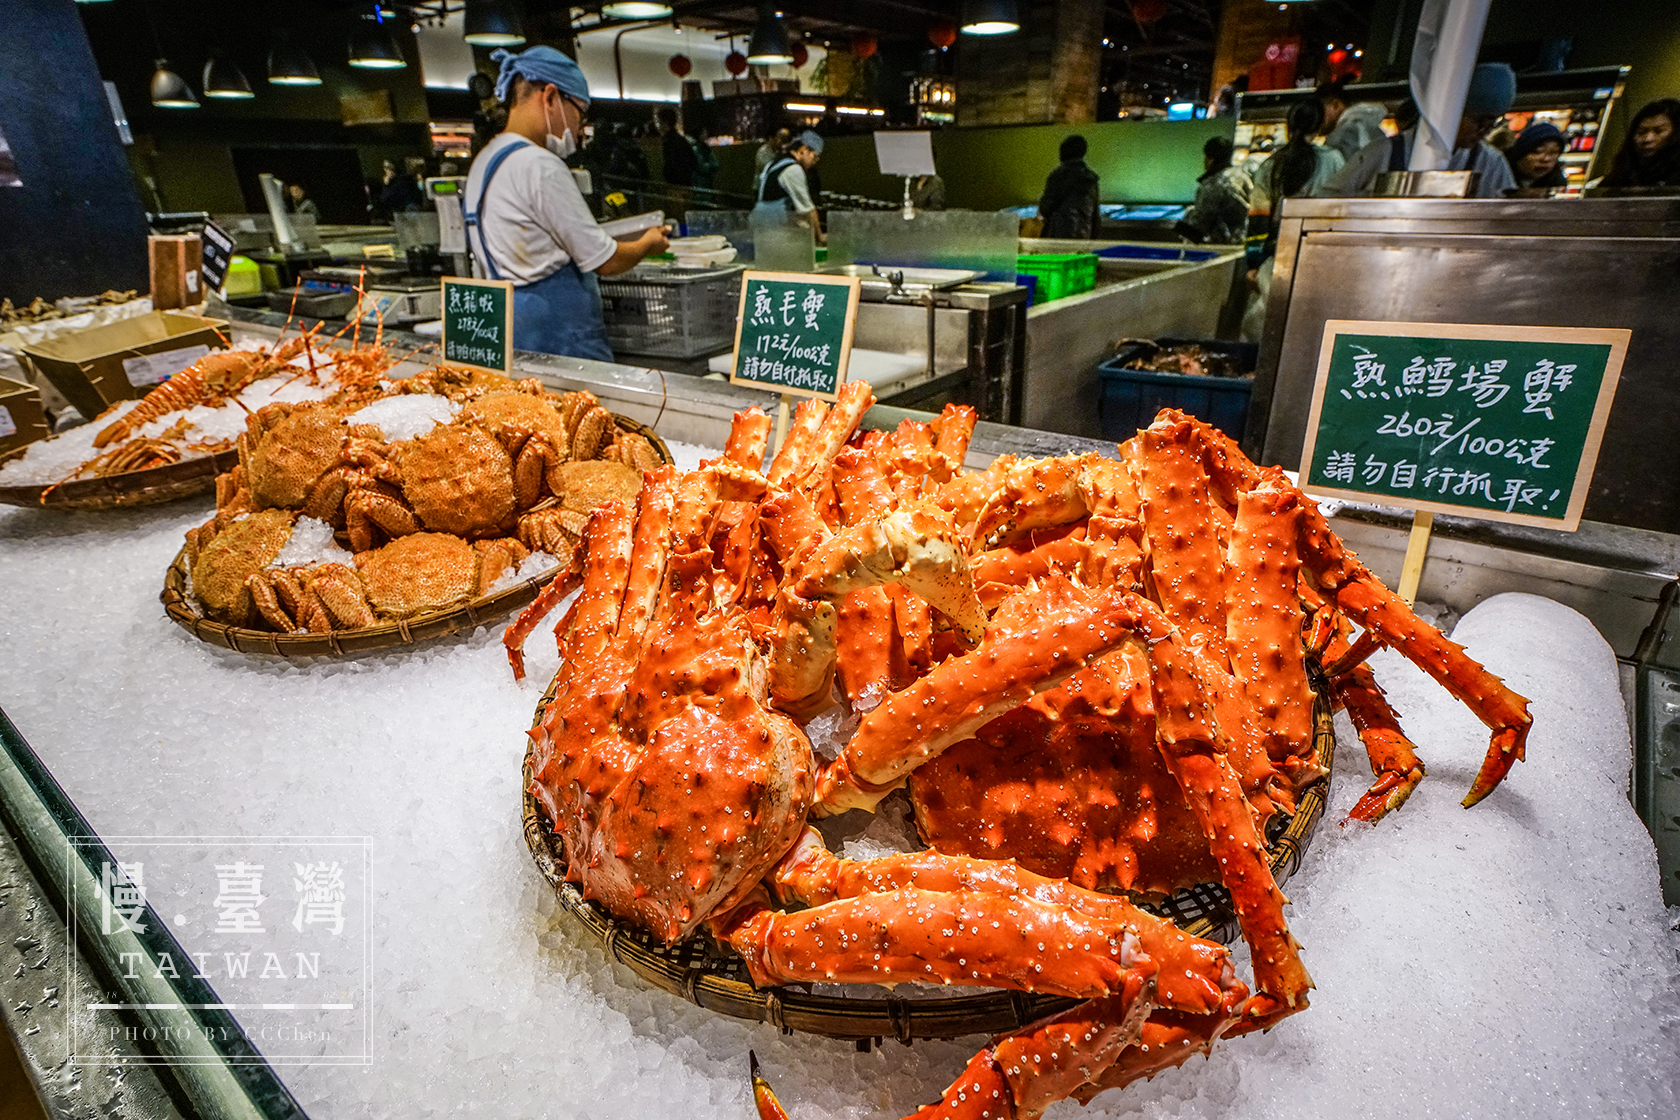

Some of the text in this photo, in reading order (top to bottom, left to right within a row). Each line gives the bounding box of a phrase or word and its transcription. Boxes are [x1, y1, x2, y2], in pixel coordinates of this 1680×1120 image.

[750, 285, 825, 331] 熟毛蟹
[757, 333, 831, 366] 172元/100公克
[1340, 346, 1577, 420] 熟鱈場蟹
[1377, 411, 1555, 469] 260元/100公克
